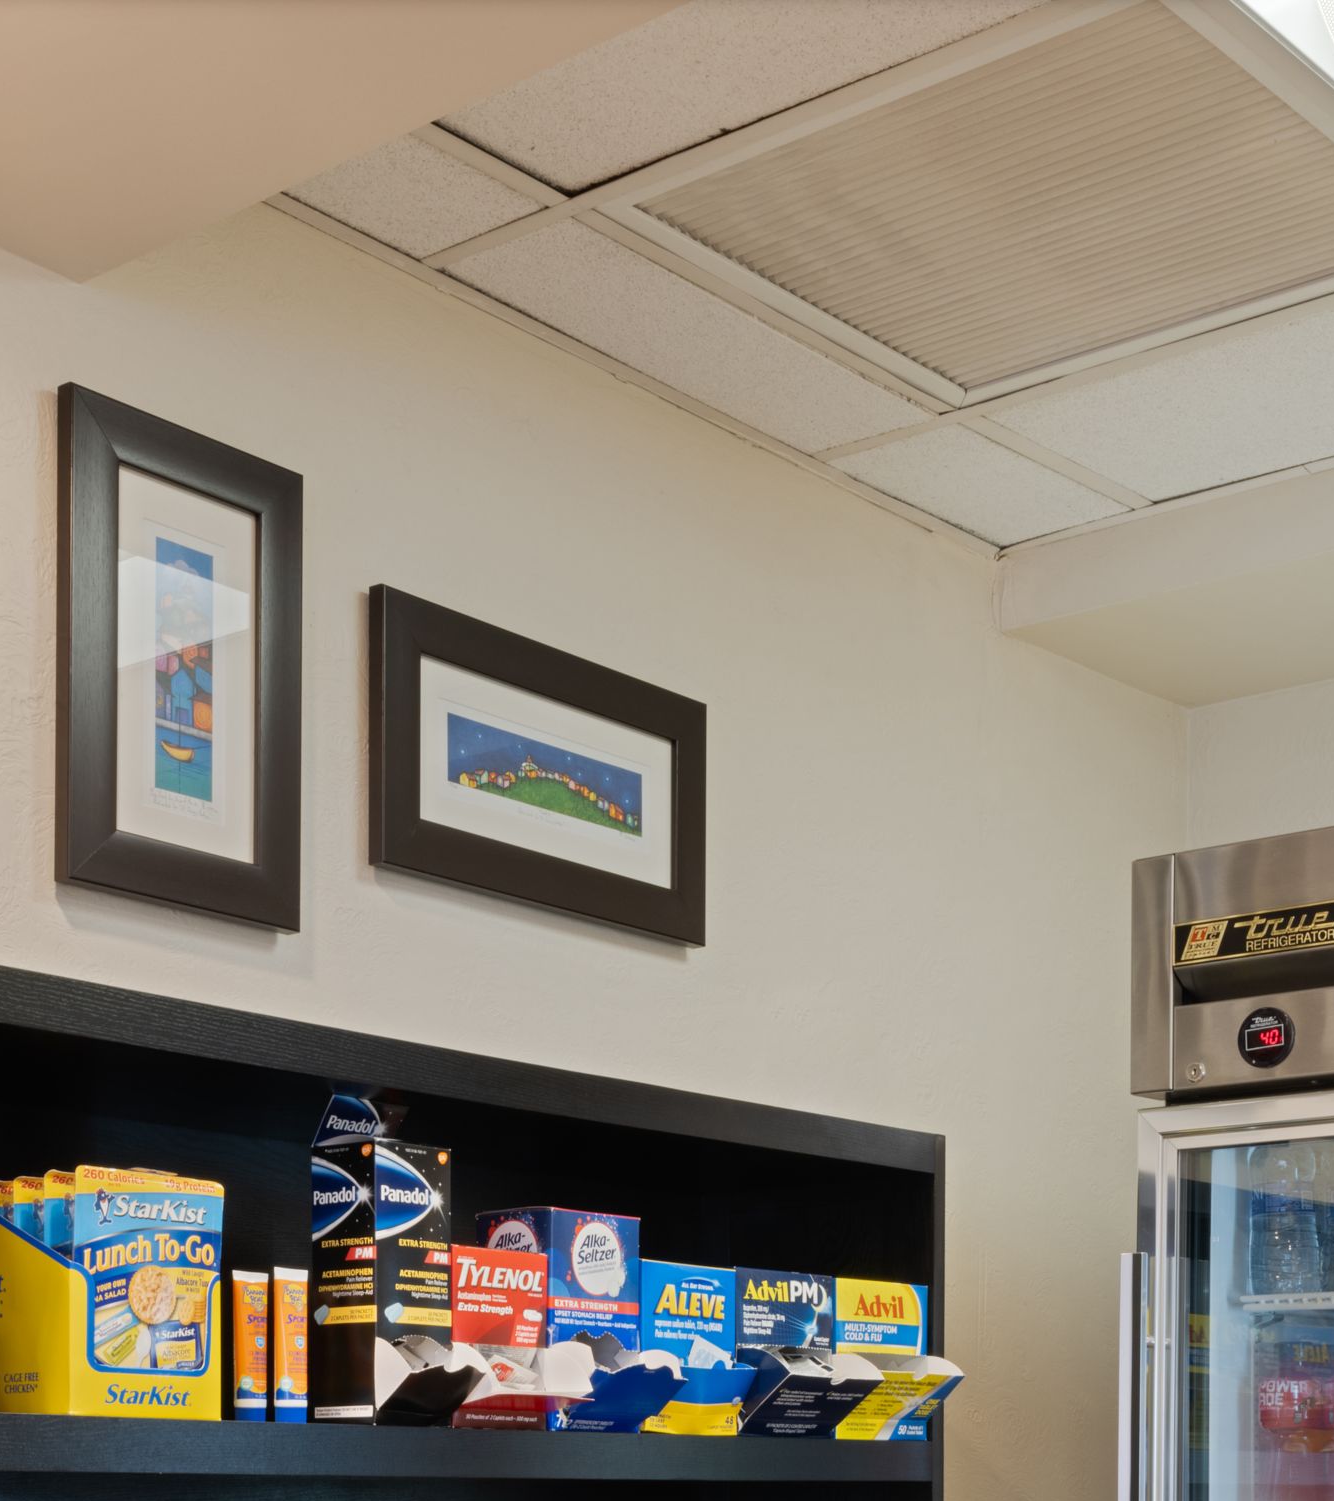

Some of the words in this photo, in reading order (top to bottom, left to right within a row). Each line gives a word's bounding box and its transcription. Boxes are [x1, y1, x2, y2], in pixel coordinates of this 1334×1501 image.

[1246, 929, 1334, 951] REFRIGERATOR
[1260, 1029, 1279, 1044] 40
[326, 1115, 376, 1134] Panadol
[380, 1184, 429, 1206] Panadol
[113, 1196, 206, 1225] StarKist
[322, 1239, 339, 1248] EXTRA
[340, 1237, 373, 1247] STRENGTH
[581, 1235, 610, 1249] Alka-
[83, 1242, 153, 1274] Lunch
[157, 1234, 214, 1268] To-Go
[355, 1248, 373, 1259] PM
[577, 1249, 616, 1264] Seltzer
[322, 1268, 373, 1278] ACETAMINOPHEN
[457, 1257, 540, 1292] TYLENOL
[105, 1288, 127, 1300] SALAD
[743, 1279, 789, 1303] Advil
[789, 1281, 818, 1304] PM
[458, 1302, 478, 1313] Extra
[480, 1304, 513, 1316] Strength
[555, 1299, 578, 1309] EXTRA
[581, 1301, 618, 1311] STRENGTH
[655, 1284, 725, 1319] ALEVE
[854, 1293, 904, 1319] Advil
[844, 1323, 898, 1334] MULTI-SYMPTOM
[844, 1331, 863, 1341] COLD
[864, 1333, 870, 1341] &
[871, 1333, 883, 1342] FLU
[4, 1374, 21, 1383] CAGE
[23, 1373, 39, 1382] FREE
[105, 1383, 190, 1406] StarKist
